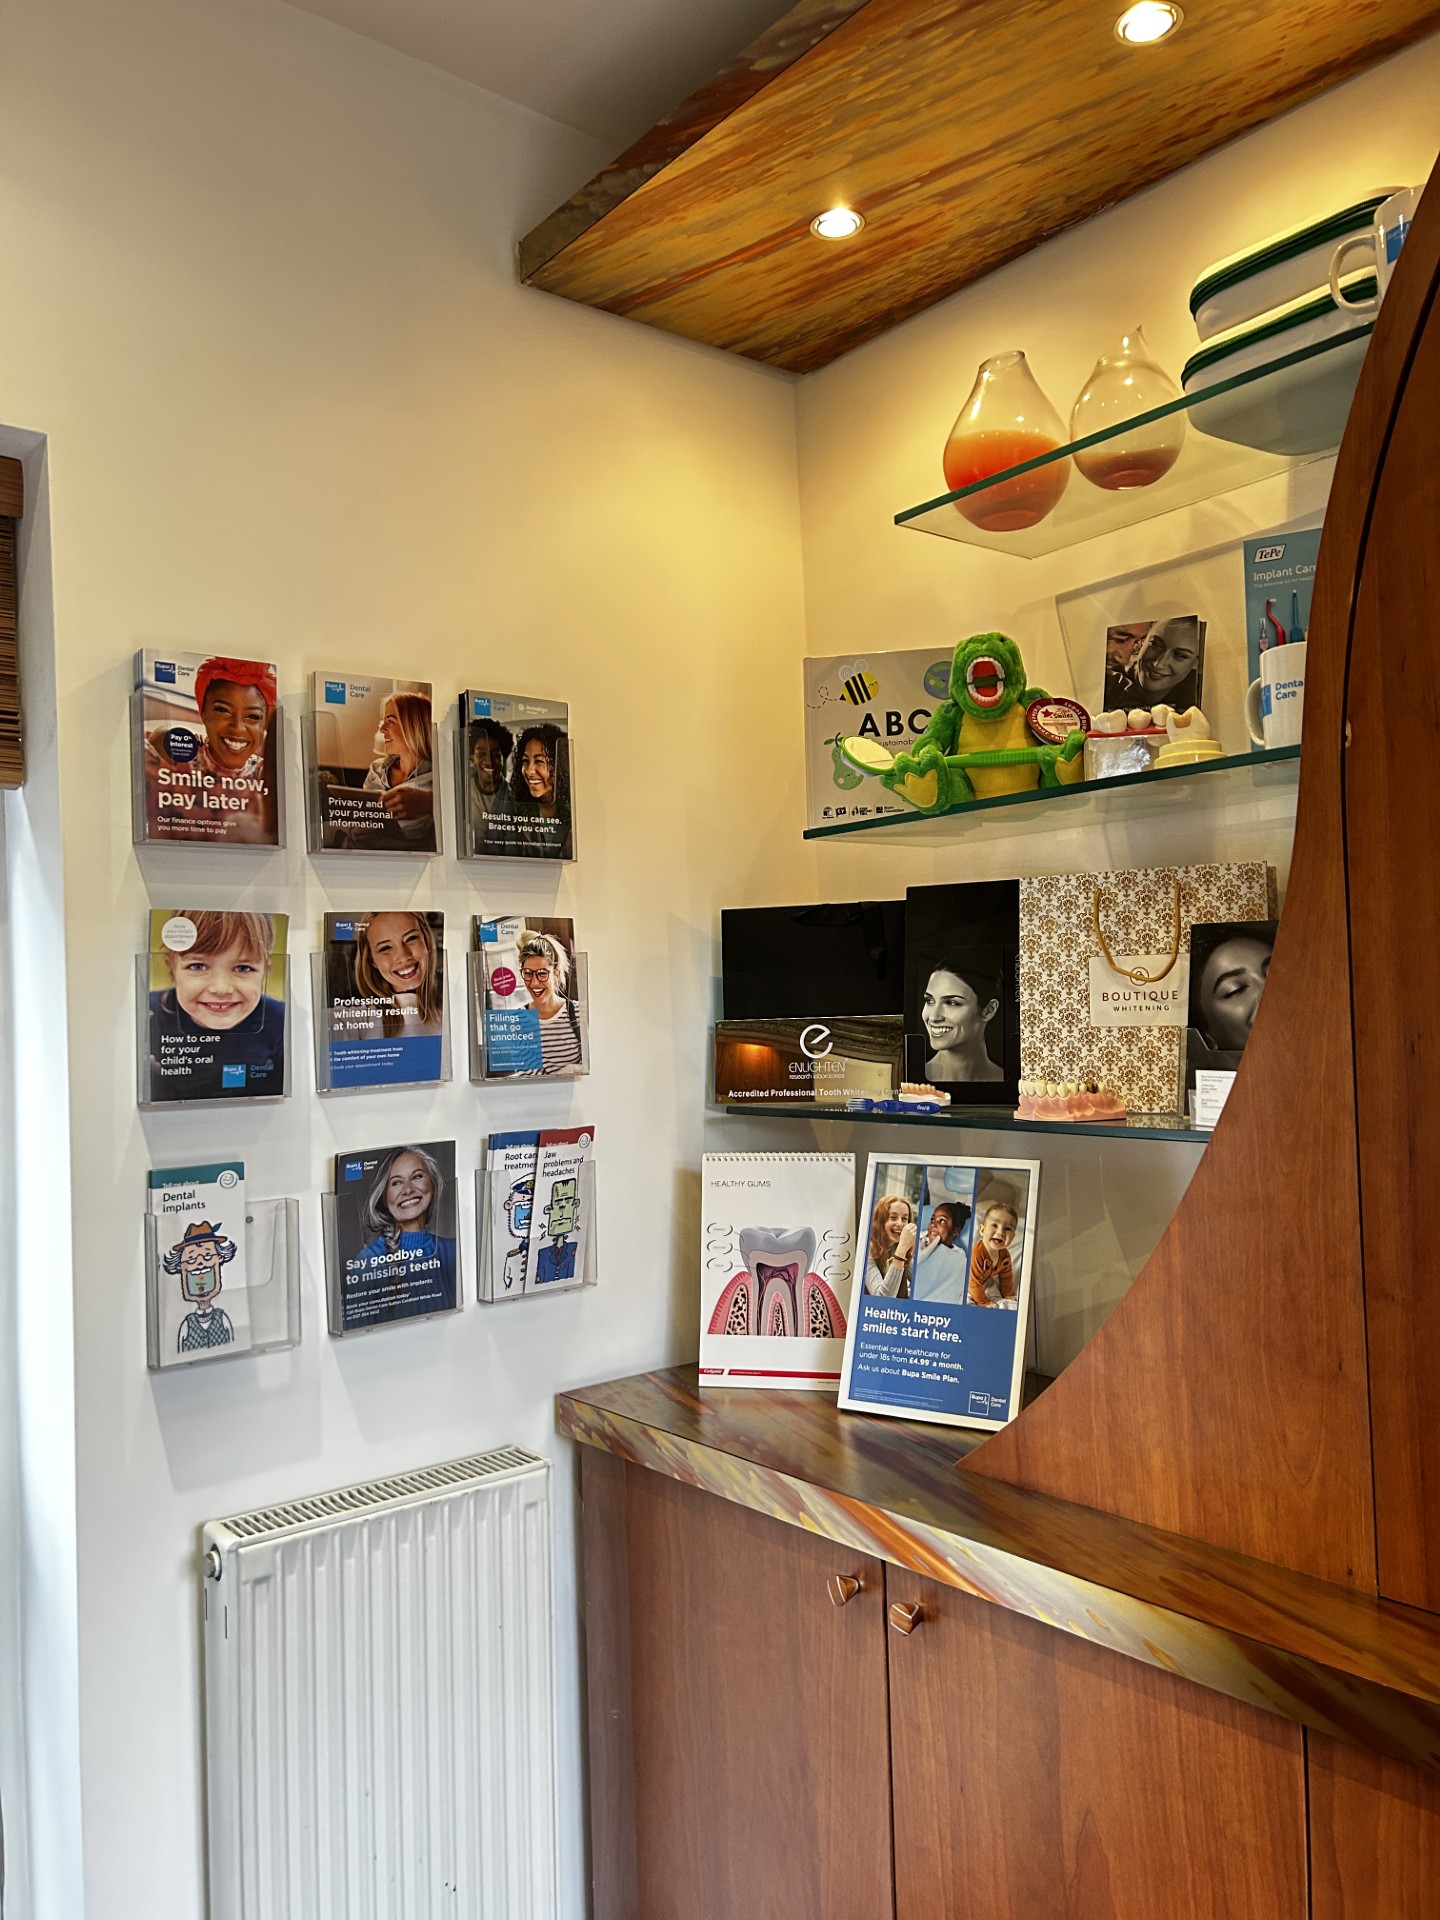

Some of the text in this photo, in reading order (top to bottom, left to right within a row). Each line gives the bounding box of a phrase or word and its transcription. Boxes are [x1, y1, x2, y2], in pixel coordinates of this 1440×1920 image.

[1258, 548, 1282, 560] TePe
[1253, 567, 1293, 581] Implant
[350, 684, 371, 692] Dental
[1275, 690, 1297, 700] Care
[857, 708, 932, 737] ABC
[880, 737, 918, 747] ustainab
[157, 767, 269, 796] Smile now,
[158, 791, 249, 810] pay later
[328, 797, 383, 809] Privacy and
[329, 808, 393, 820] your personal
[482, 812, 511, 822] Results
[513, 815, 529, 823] you
[172, 817, 196, 825] finance
[197, 819, 221, 827] options
[329, 818, 384, 829] information
[488, 822, 516, 831] Braces
[517, 825, 533, 833] you
[333, 995, 395, 1007] Professional
[1102, 989, 1179, 1003] BOUTIQUE
[333, 1006, 419, 1019] whitening results
[489, 1013, 520, 1023] Fillings
[333, 1020, 375, 1031] at home
[490, 1023, 521, 1033] that go
[160, 1034, 221, 1044] How to care
[490, 1032, 534, 1042] unnoticed
[160, 1045, 201, 1055] for your
[160, 1055, 214, 1065] child's oral
[160, 1066, 192, 1075] health
[789, 1061, 846, 1073] ENLIGHTEN
[728, 1089, 769, 1098] Accredited
[770, 1089, 816, 1097] Professional
[819, 1088, 842, 1096] Tooth
[843, 1087, 882, 1096] Whitening
[505, 1152, 522, 1161] Root
[544, 1151, 557, 1159] Jaw
[543, 1155, 584, 1169] problems and
[542, 1167, 575, 1177] headaches
[711, 1180, 771, 1188] HEALTHY GUMS
[163, 1190, 195, 1202] Dental
[163, 1201, 206, 1213] implants
[346, 1248, 423, 1270] Say goodbye
[346, 1258, 441, 1284] to missing teeth
[346, 1291, 367, 1299] Restore
[368, 1287, 381, 1295] your
[410, 1278, 433, 1287] implants
[864, 1306, 951, 1328] Healthy, happy
[862, 1322, 962, 1343] smiles start here.
[860, 1342, 951, 1360] Essential oral healthcare for
[859, 1351, 879, 1361] under
[880, 1353, 890, 1361] 18s
[891, 1354, 908, 1363] from
[938, 1361, 964, 1371] month.
[857, 1363, 871, 1371] Ask
[880, 1366, 901, 1375] about
[901, 1369, 920, 1379] Bupa
[921, 1371, 941, 1381] Smile
[942, 1374, 960, 1383] Plan.
[990, 1395, 1007, 1404] Dental
